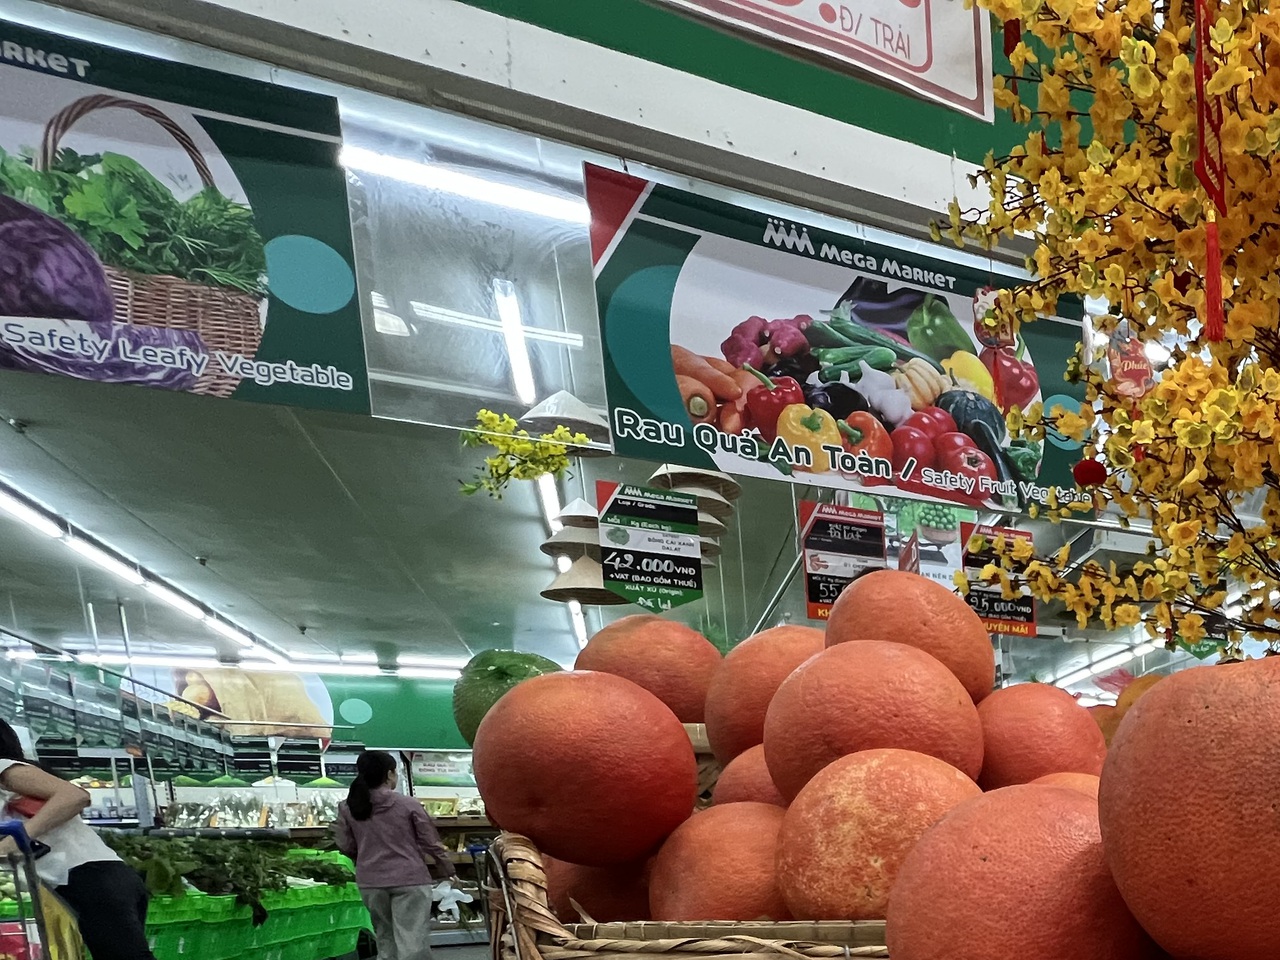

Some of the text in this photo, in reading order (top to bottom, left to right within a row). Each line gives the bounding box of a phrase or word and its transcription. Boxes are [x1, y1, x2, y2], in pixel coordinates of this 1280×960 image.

[2, 321, 354, 391] Safety Leafy Vegetable
[614, 407, 685, 448] Rau
[692, 422, 760, 460] Quả
[769, 435, 814, 466] An
[822, 444, 893, 479] Toàn
[900, 457, 918, 482] /
[922, 468, 975, 494] Safety
[979, 476, 1017, 497] Fruit
[604, 551, 675, 573] 42.000
[632, 574, 651, 582] (BAO
[673, 579, 697, 588] THUẾ)
